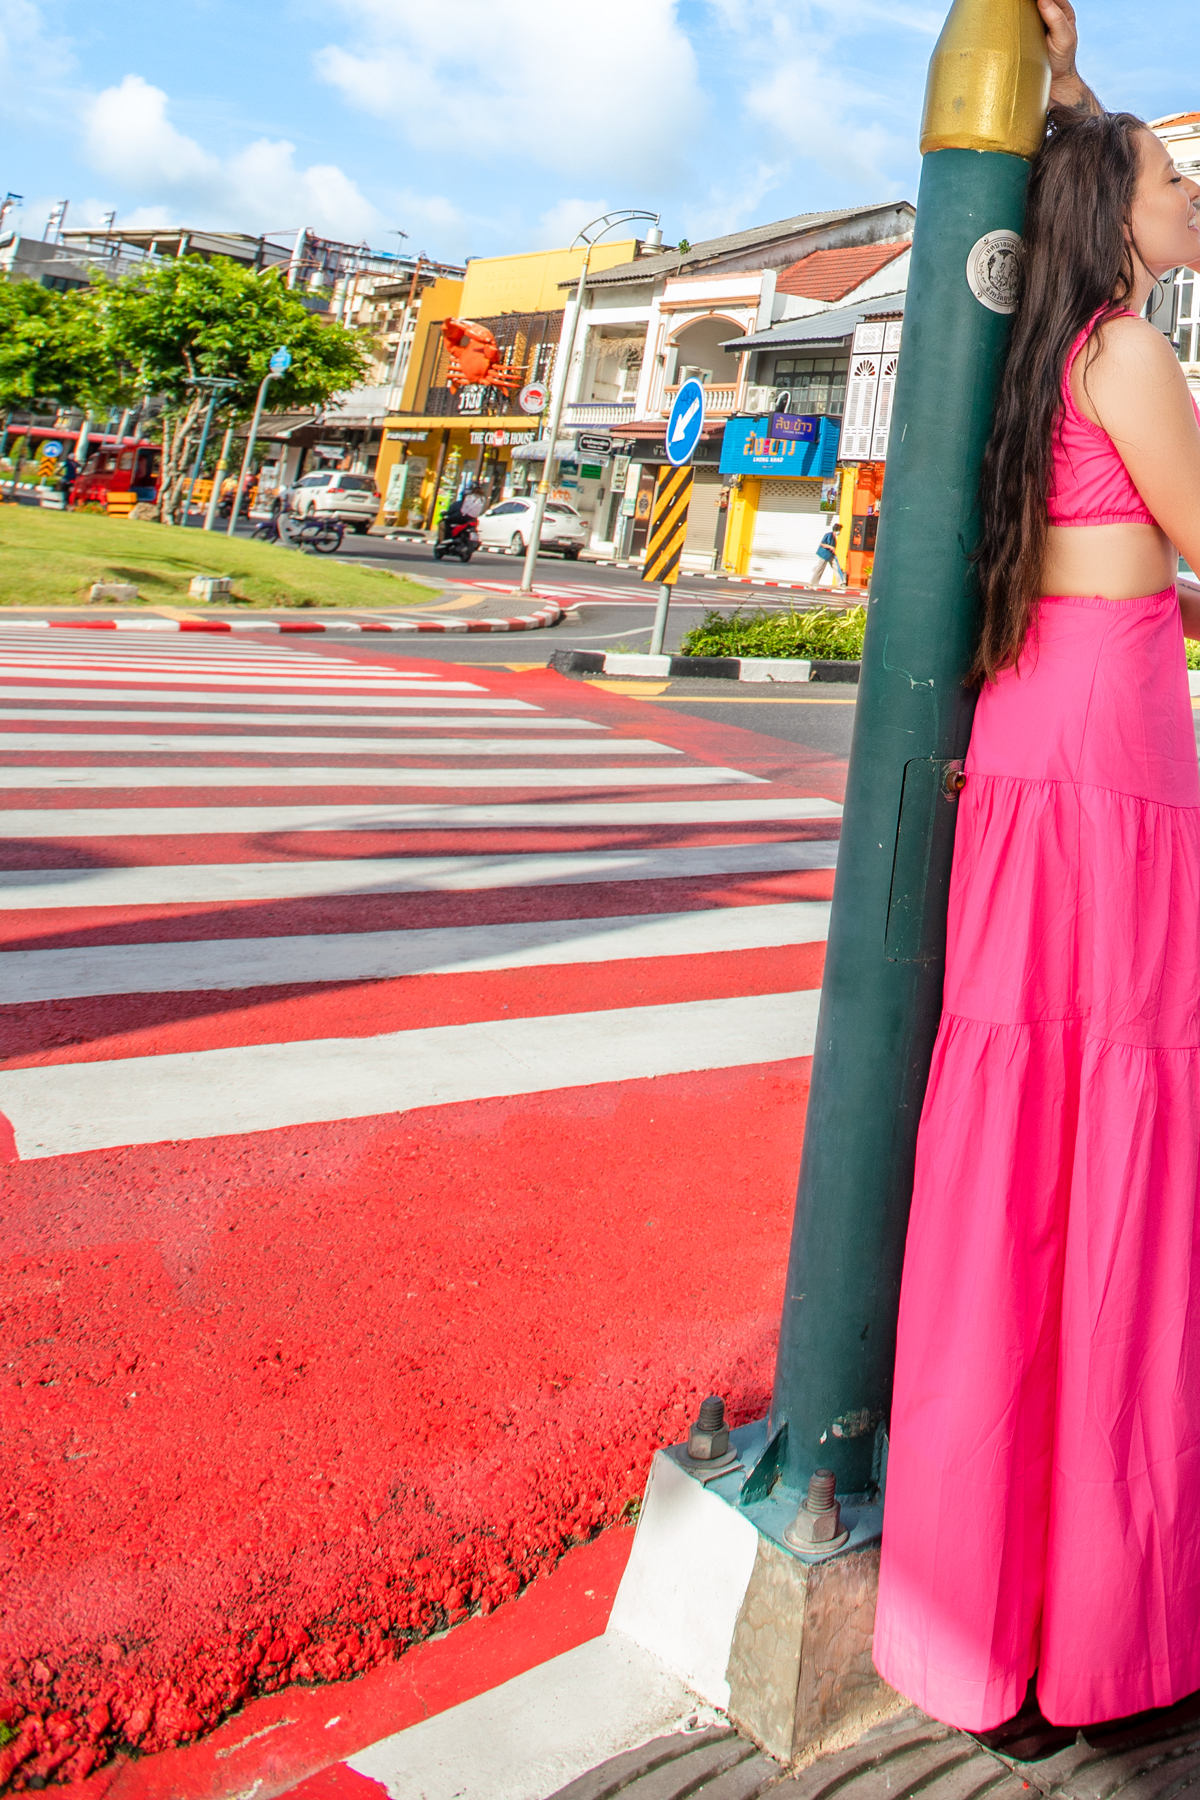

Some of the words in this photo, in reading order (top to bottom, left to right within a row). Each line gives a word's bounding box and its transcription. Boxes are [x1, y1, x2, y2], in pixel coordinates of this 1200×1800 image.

[470, 431, 485, 445] THE
[484, 430, 510, 446] CRB
[510, 432, 536, 445] HOUSE
